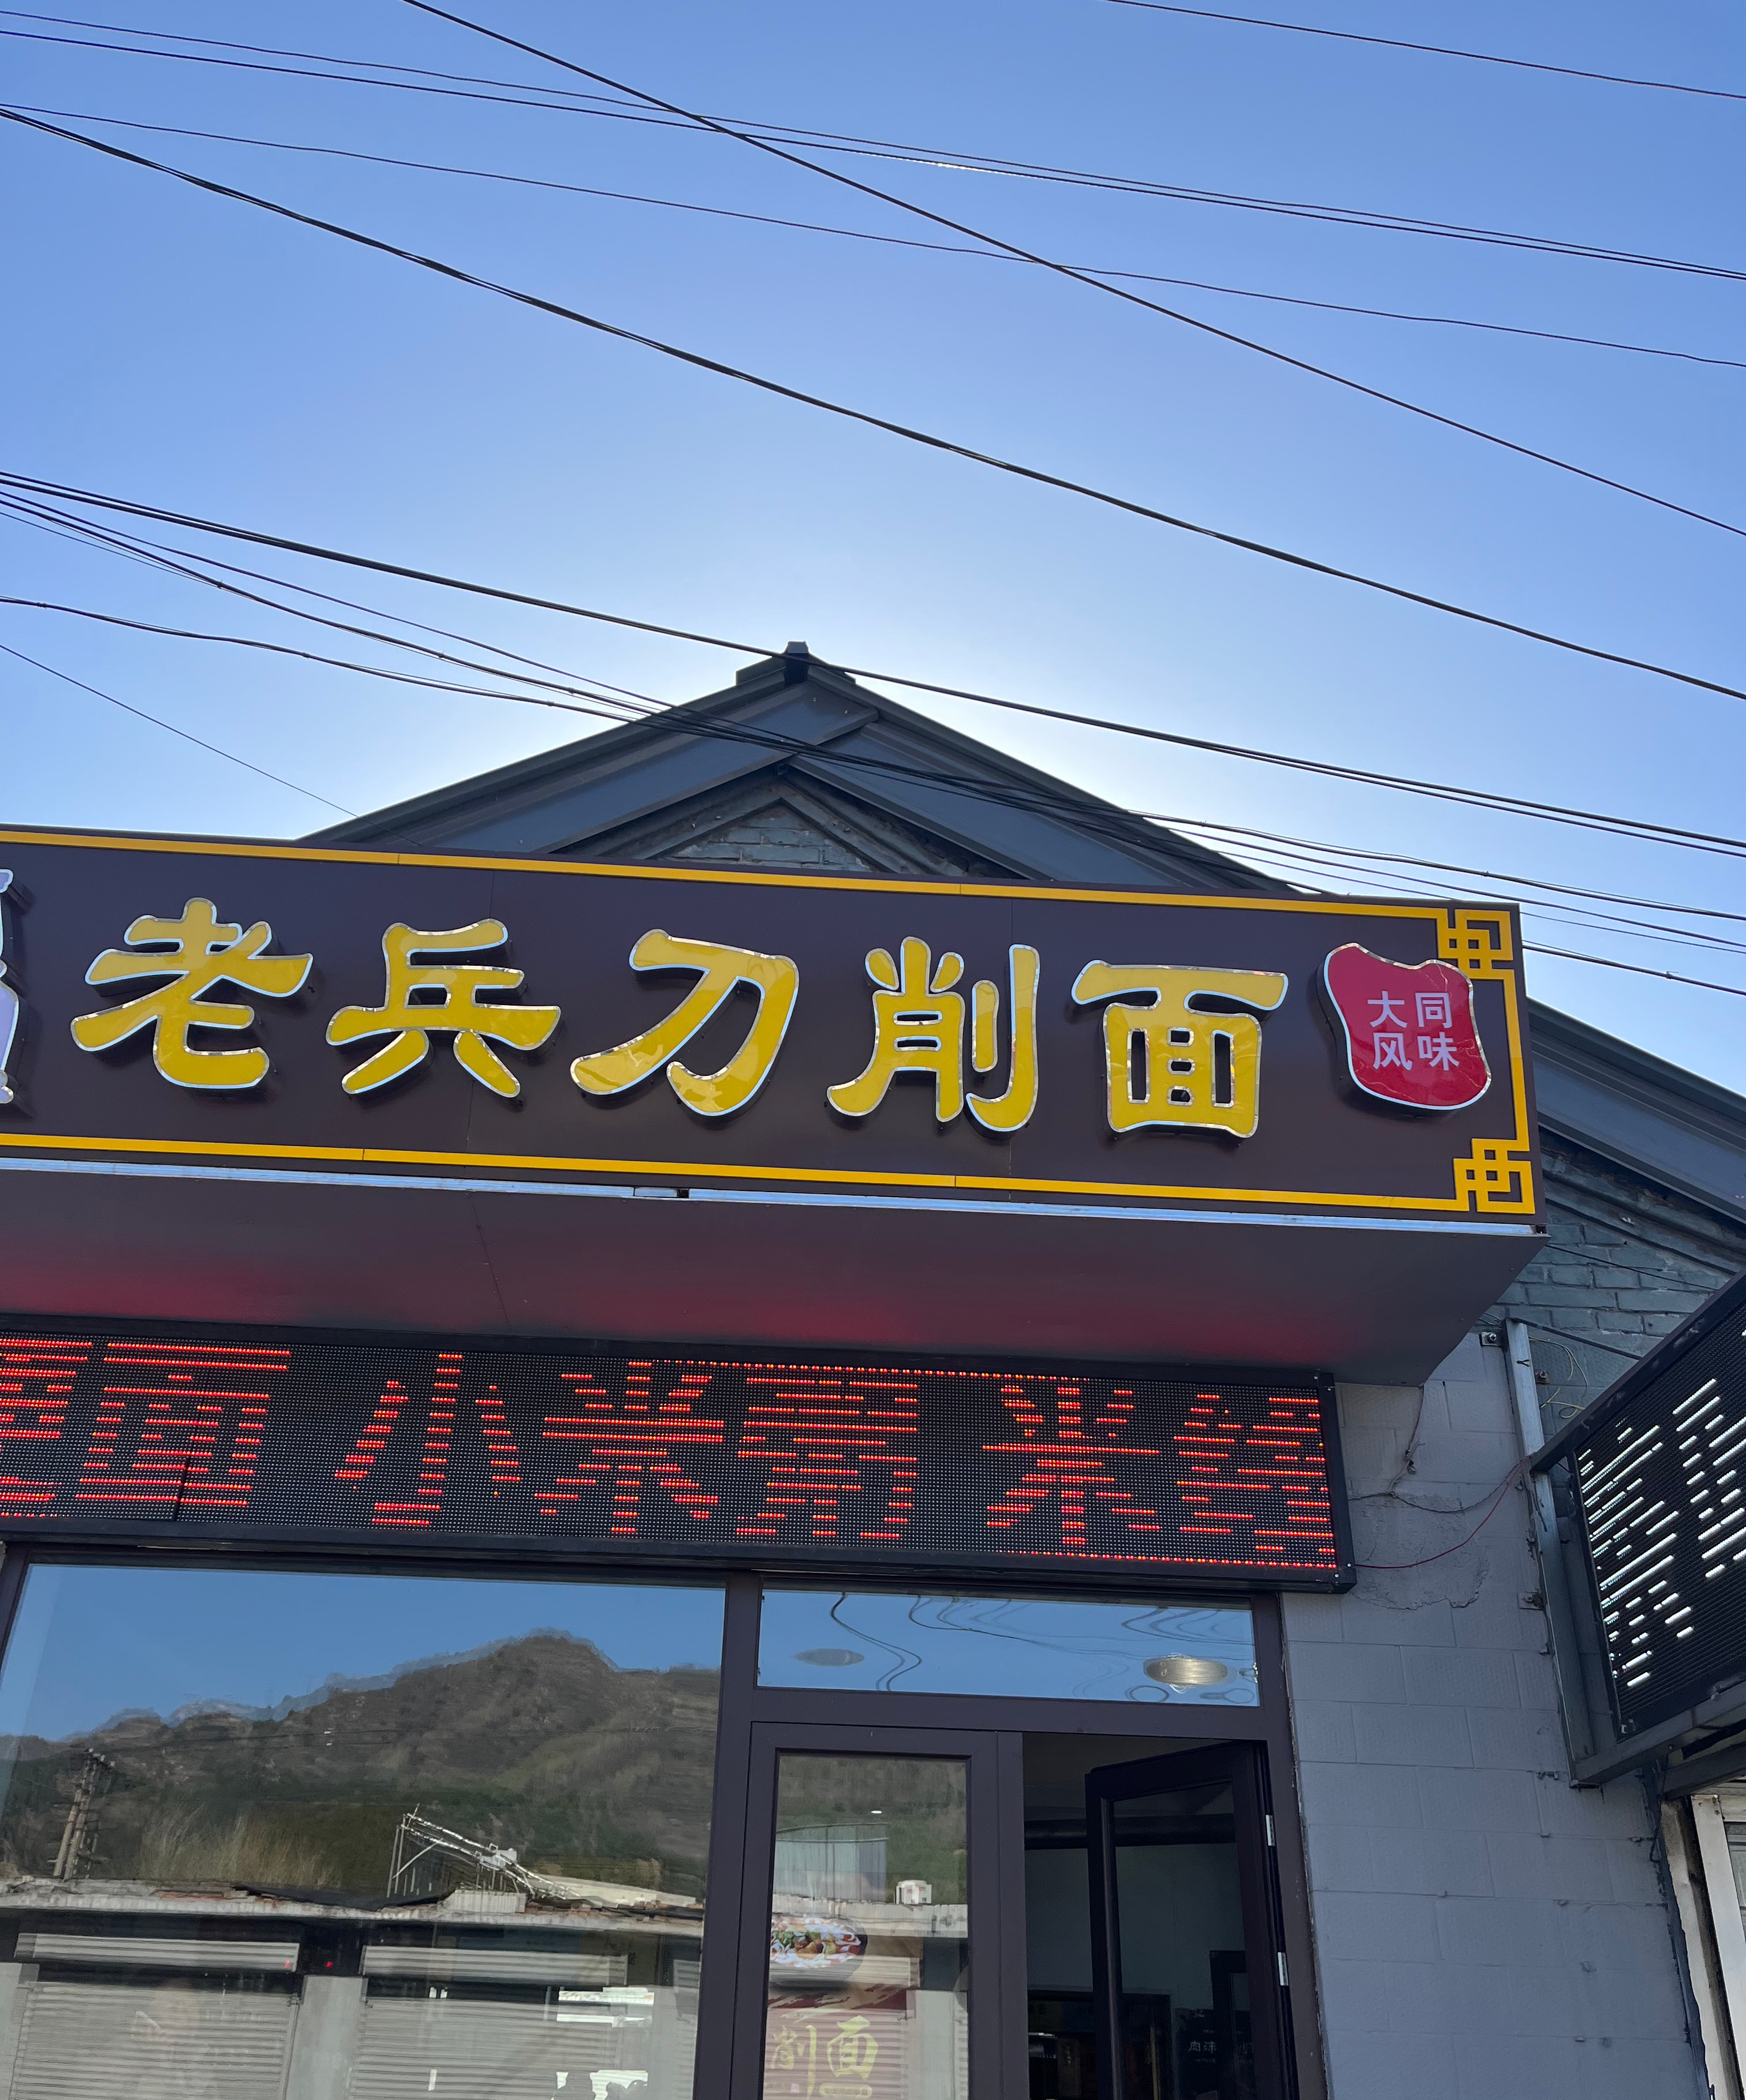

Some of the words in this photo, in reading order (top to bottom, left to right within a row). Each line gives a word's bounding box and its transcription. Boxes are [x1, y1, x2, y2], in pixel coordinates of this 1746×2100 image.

[70, 897, 1288, 1138] 老兵刀削面
[1367, 990, 1453, 1029] 大同
[1372, 1032, 1460, 1071] 风味
